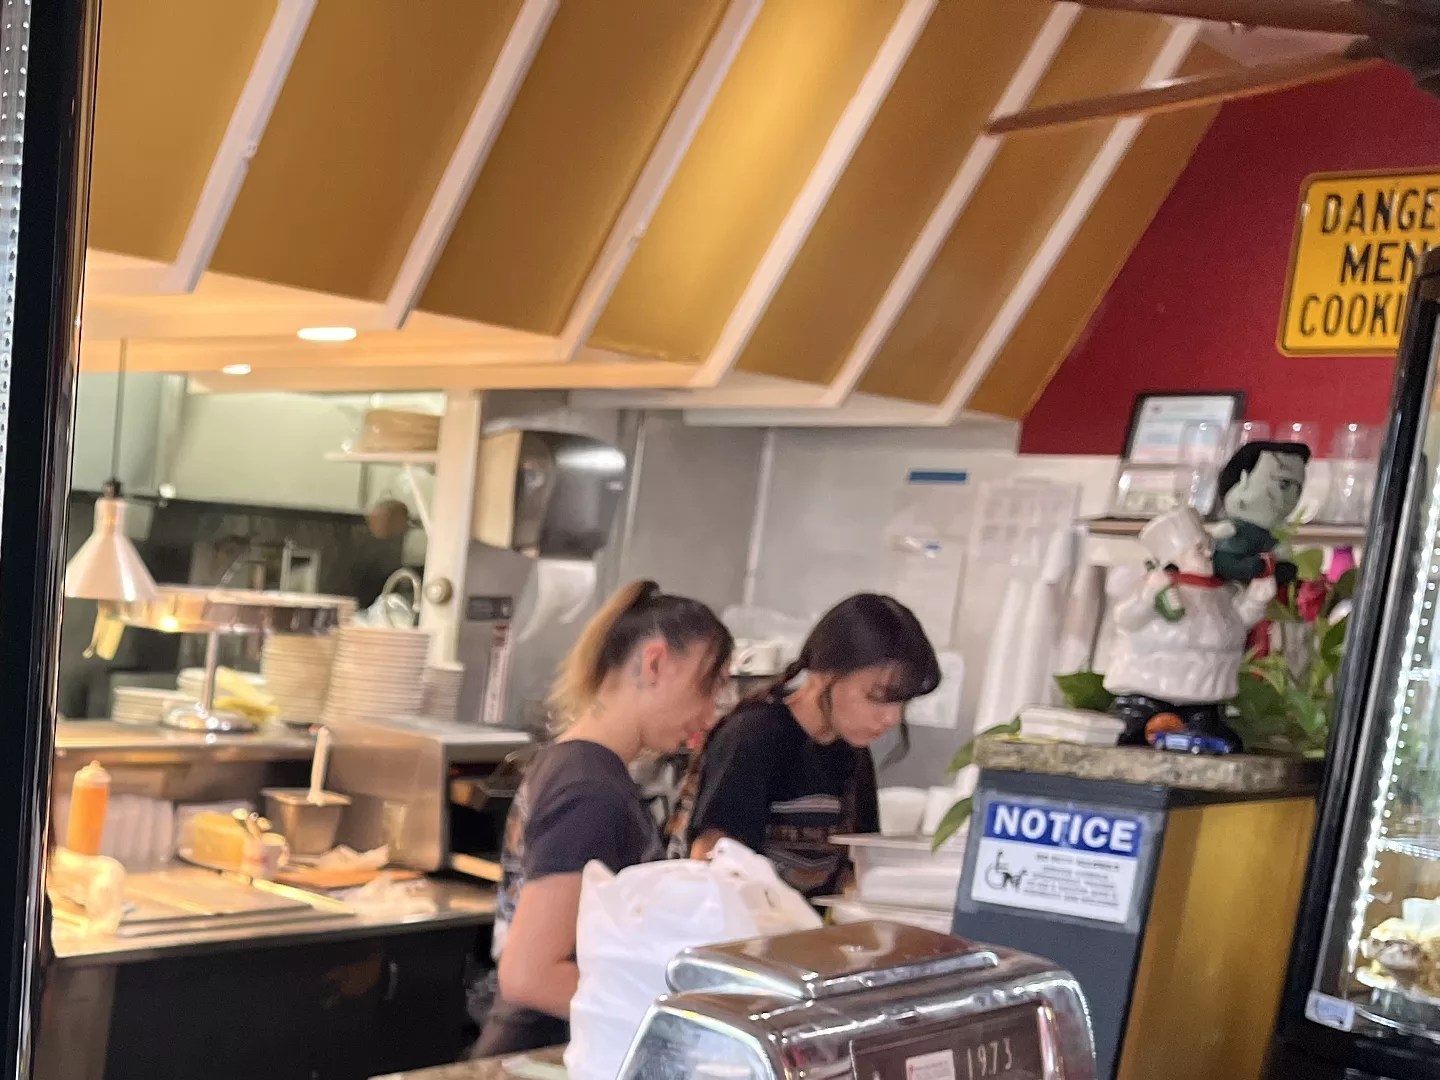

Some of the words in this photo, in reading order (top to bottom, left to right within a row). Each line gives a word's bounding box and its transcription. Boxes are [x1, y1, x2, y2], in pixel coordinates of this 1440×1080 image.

[1322, 188, 1440, 234] DANGE
[1340, 240, 1428, 285] MEN
[1300, 293, 1404, 336] COOKI
[993, 804, 1138, 852] NOTICE
